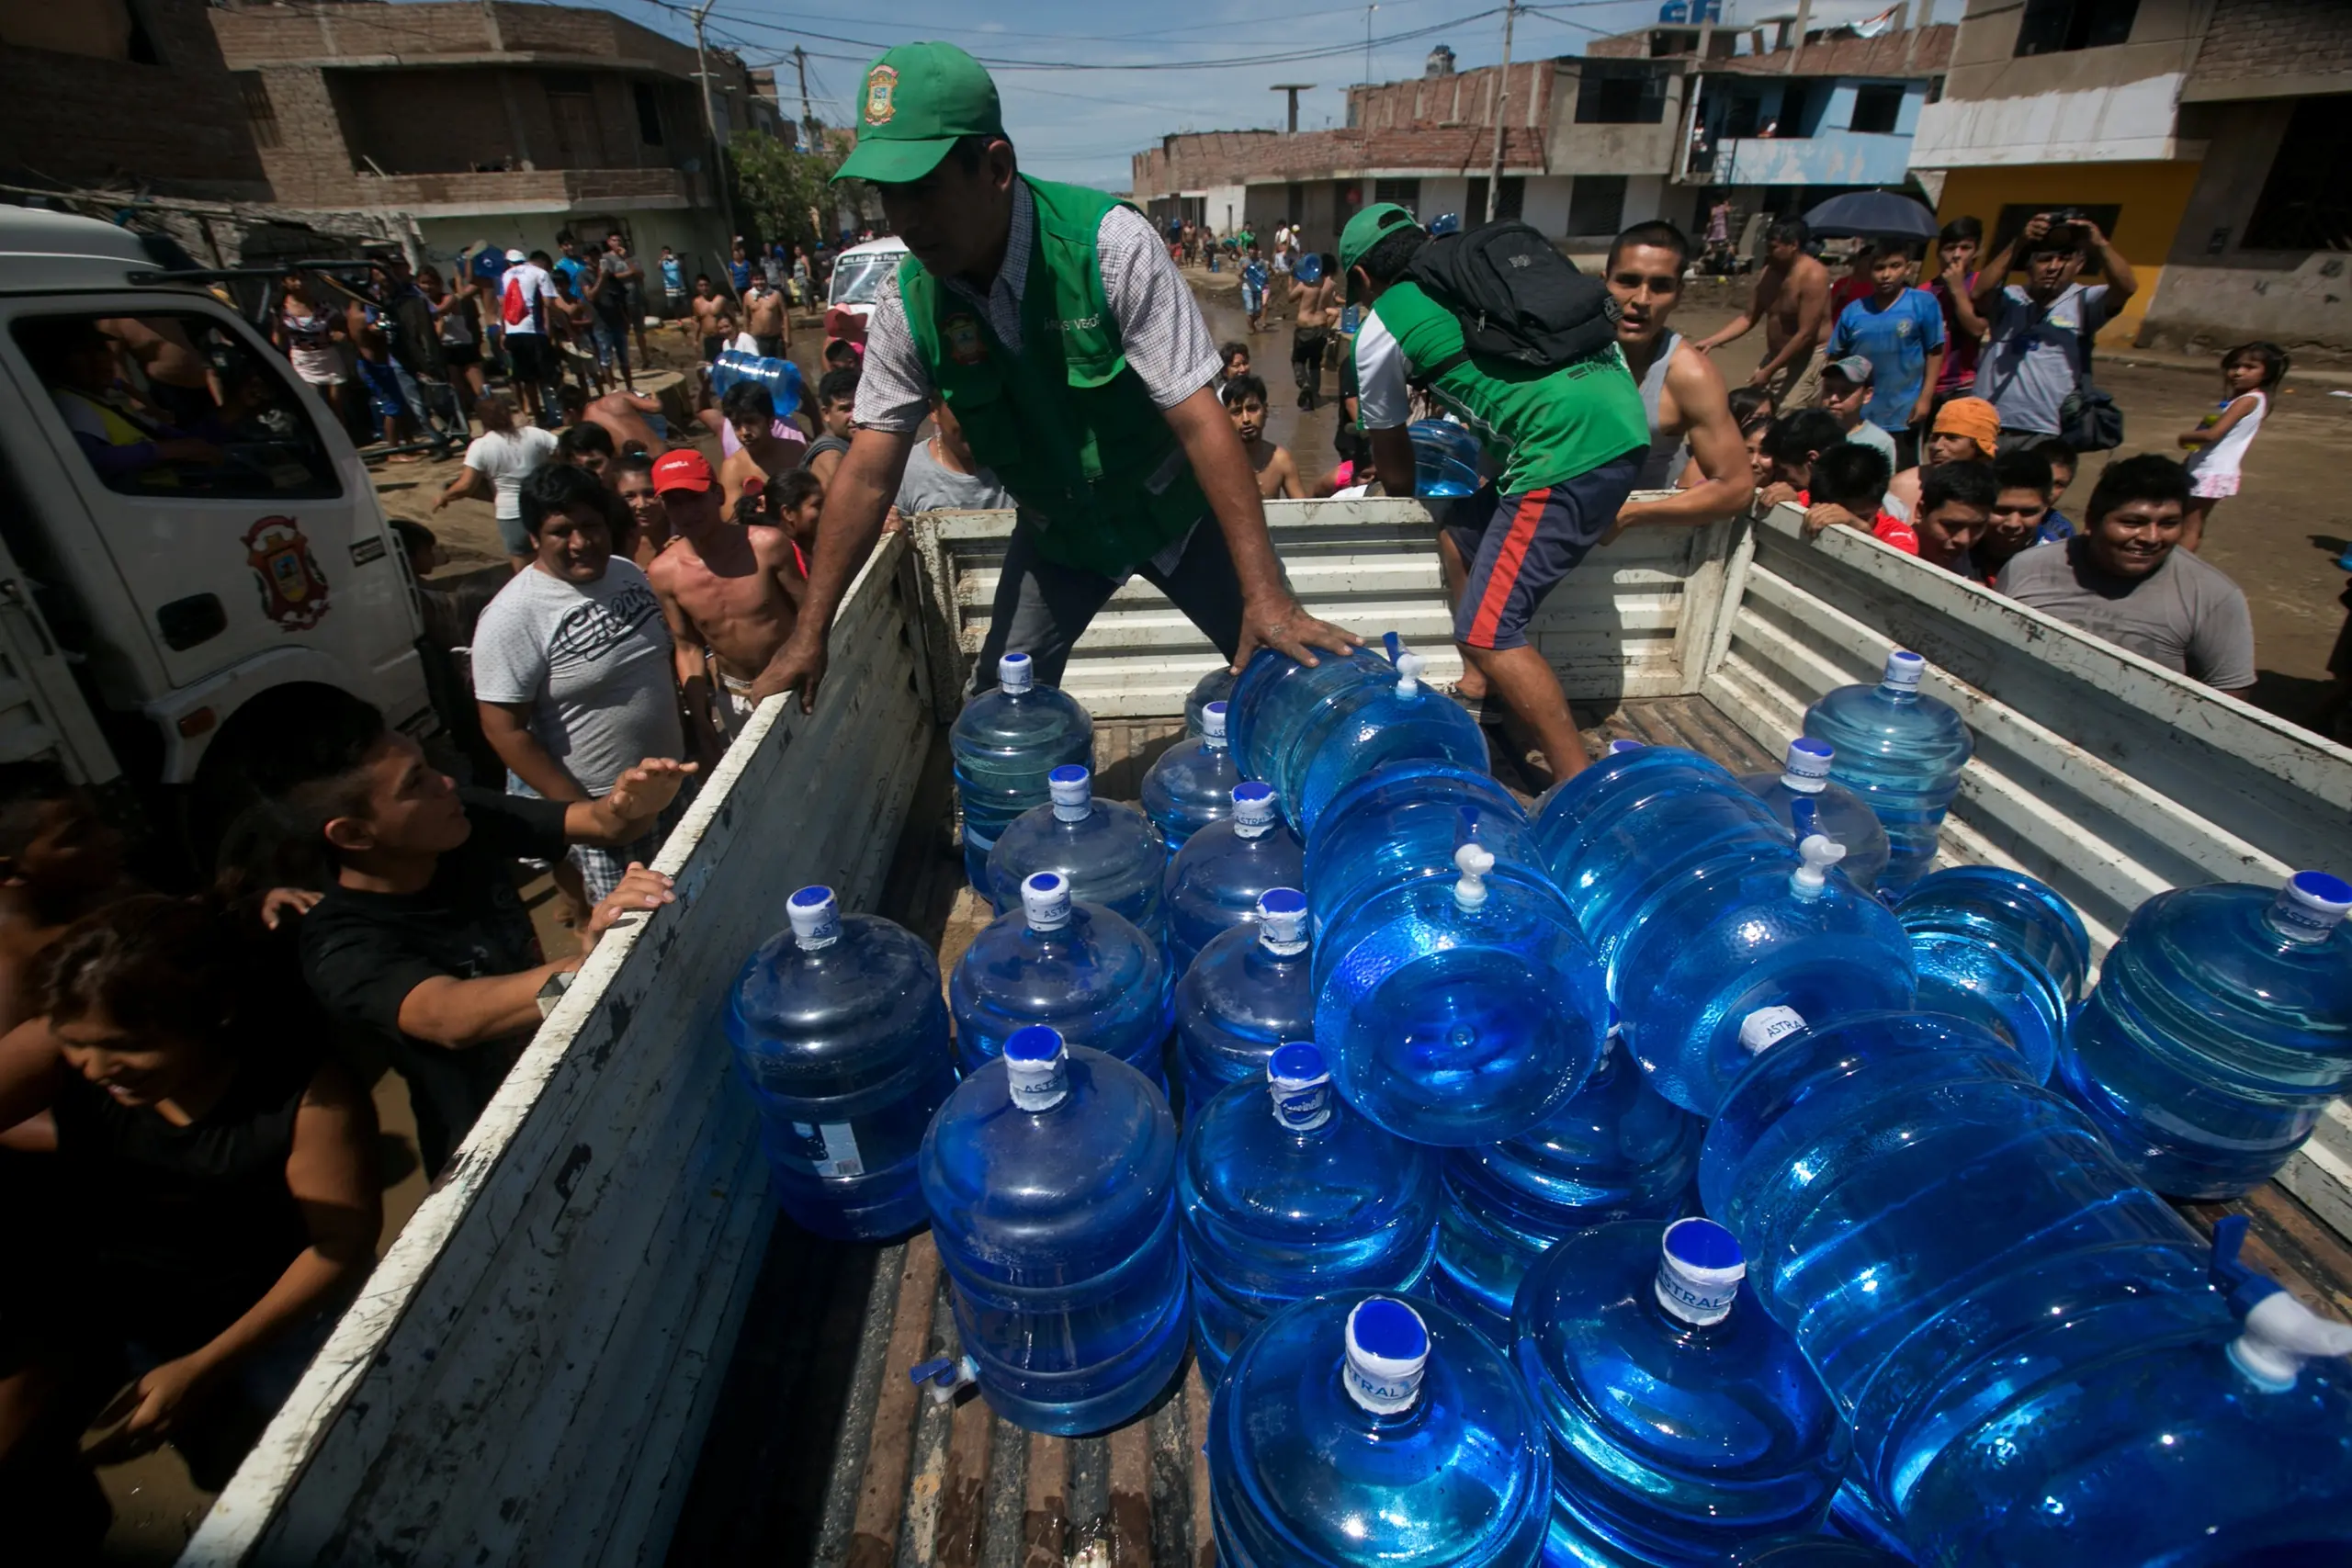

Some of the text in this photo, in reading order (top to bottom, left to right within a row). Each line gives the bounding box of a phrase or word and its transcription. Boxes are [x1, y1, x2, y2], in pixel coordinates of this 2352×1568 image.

[812, 919, 837, 937] AST
[1767, 1020, 1803, 1038] ASTRA
[1351, 1372, 1398, 1397] TRAL
